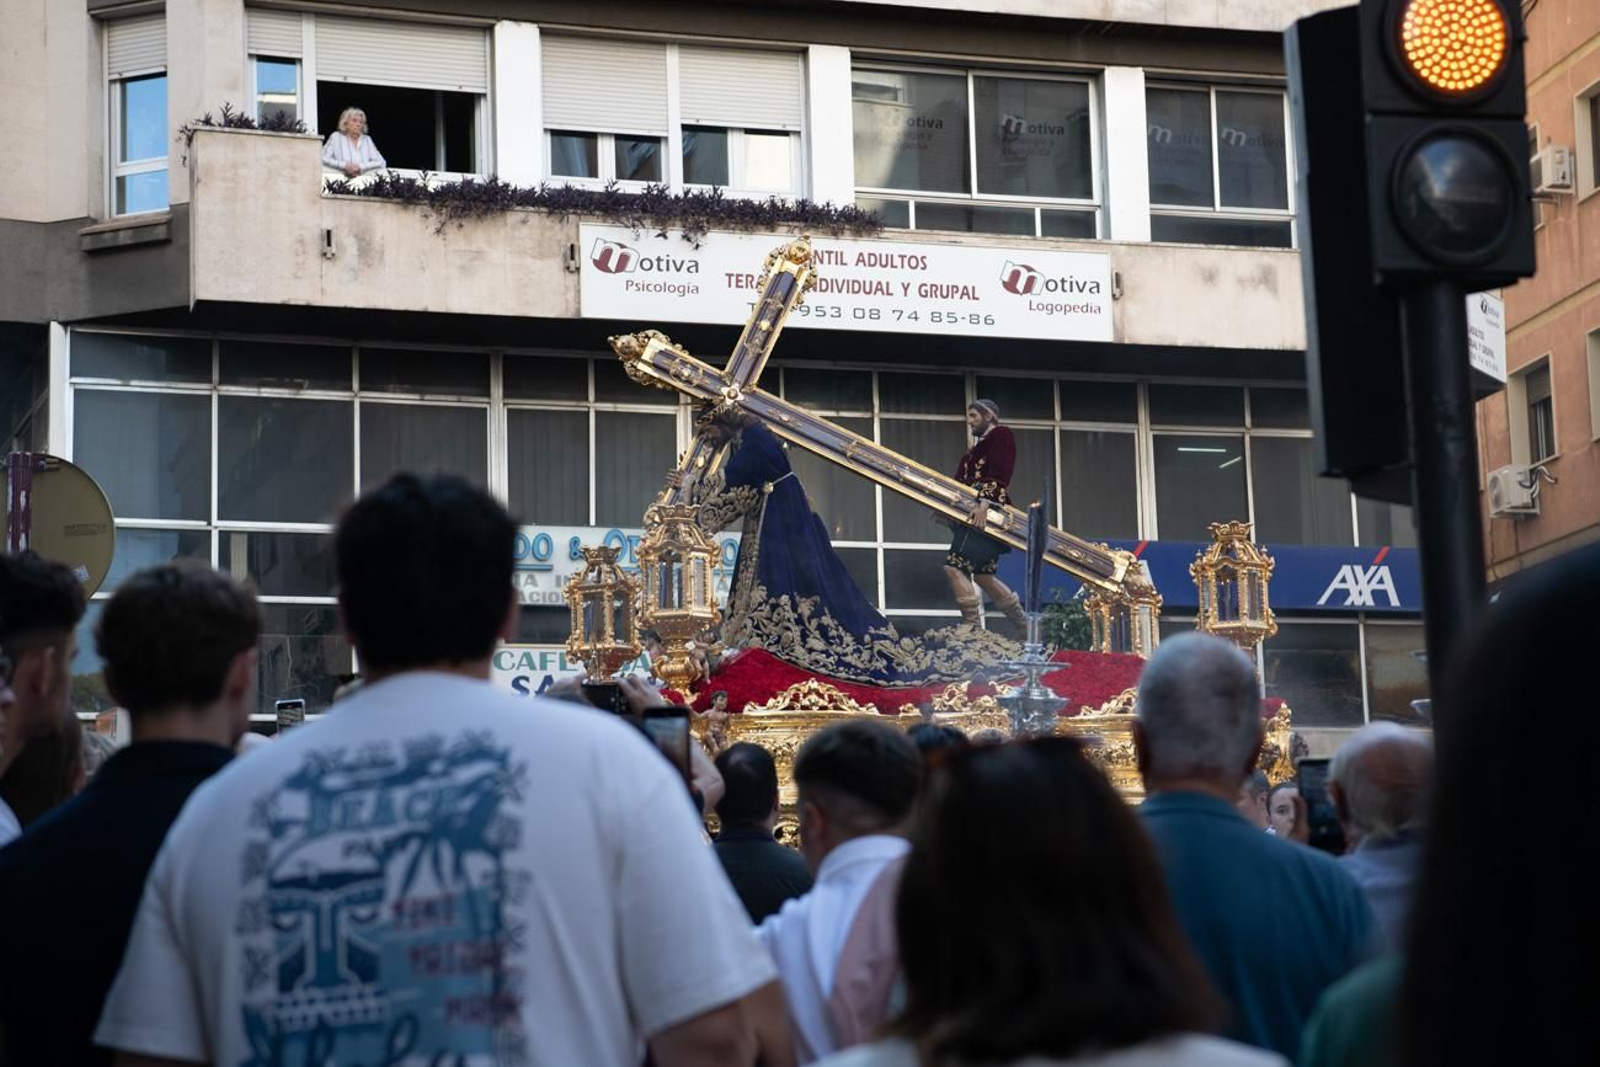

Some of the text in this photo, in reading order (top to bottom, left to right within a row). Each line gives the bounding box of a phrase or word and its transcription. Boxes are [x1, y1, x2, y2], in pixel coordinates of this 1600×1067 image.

[907, 116, 944, 129] otiva
[855, 251, 928, 271] ADULTOS
[901, 281, 911, 297] Y
[917, 282, 980, 300] GRUPAL
[798, 305, 995, 325] 953 08 74 85-86
[1028, 299, 1101, 315] Logopedia
[1317, 564, 1400, 606] AXA
